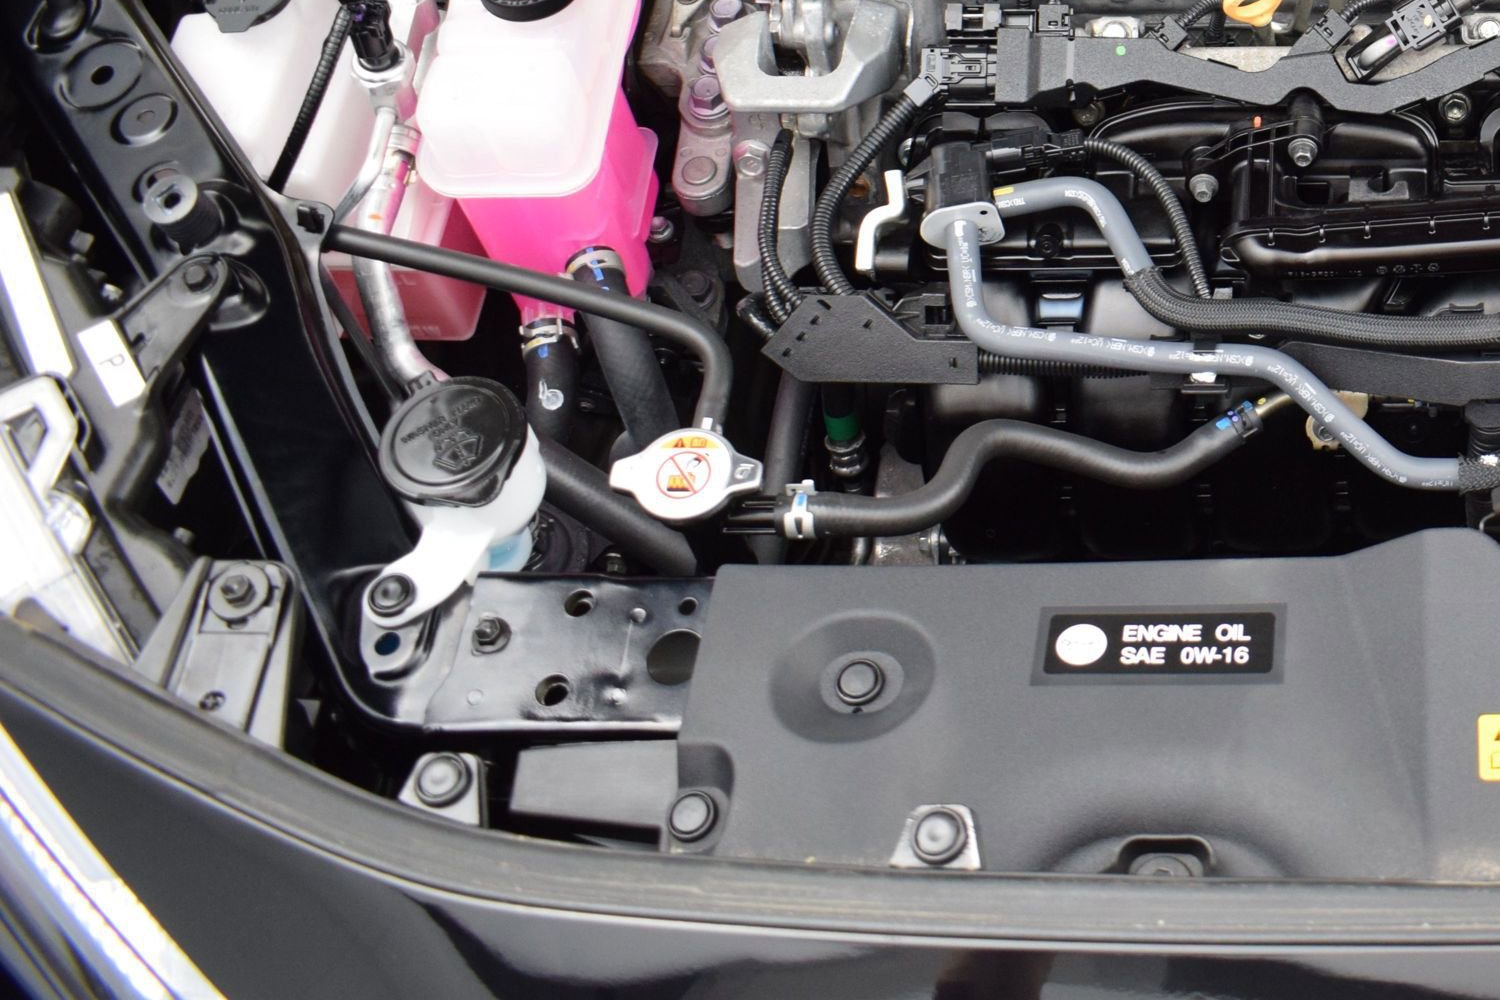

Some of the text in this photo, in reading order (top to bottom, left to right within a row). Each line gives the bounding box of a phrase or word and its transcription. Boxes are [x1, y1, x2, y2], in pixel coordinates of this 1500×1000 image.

[1122, 623, 1252, 642] ENGINE OIL
[1119, 646, 1250, 665] SAE 0W-16
